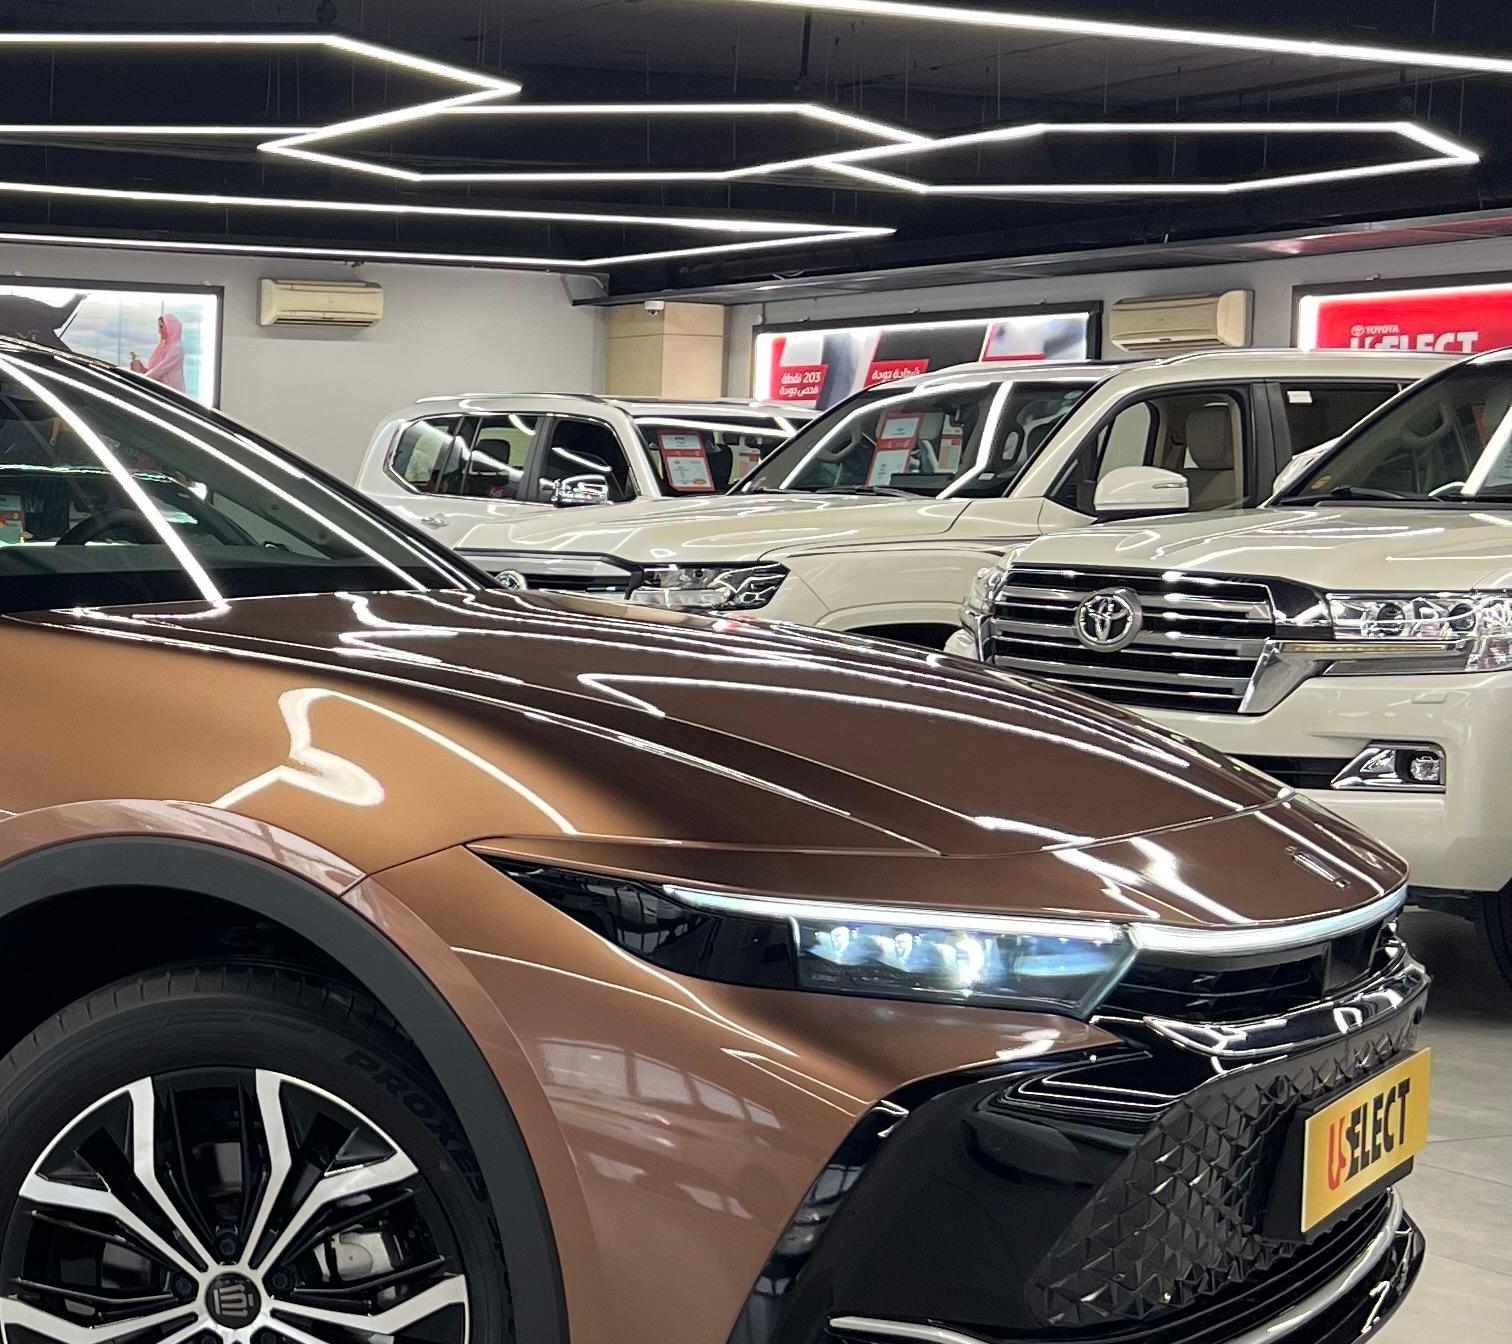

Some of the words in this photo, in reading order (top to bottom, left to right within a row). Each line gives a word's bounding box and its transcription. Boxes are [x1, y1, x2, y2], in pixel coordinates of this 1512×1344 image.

[1365, 324, 1400, 334] TOYOTA
[803, 371, 822, 384] 203
[343, 1050, 488, 1204] PROXES
